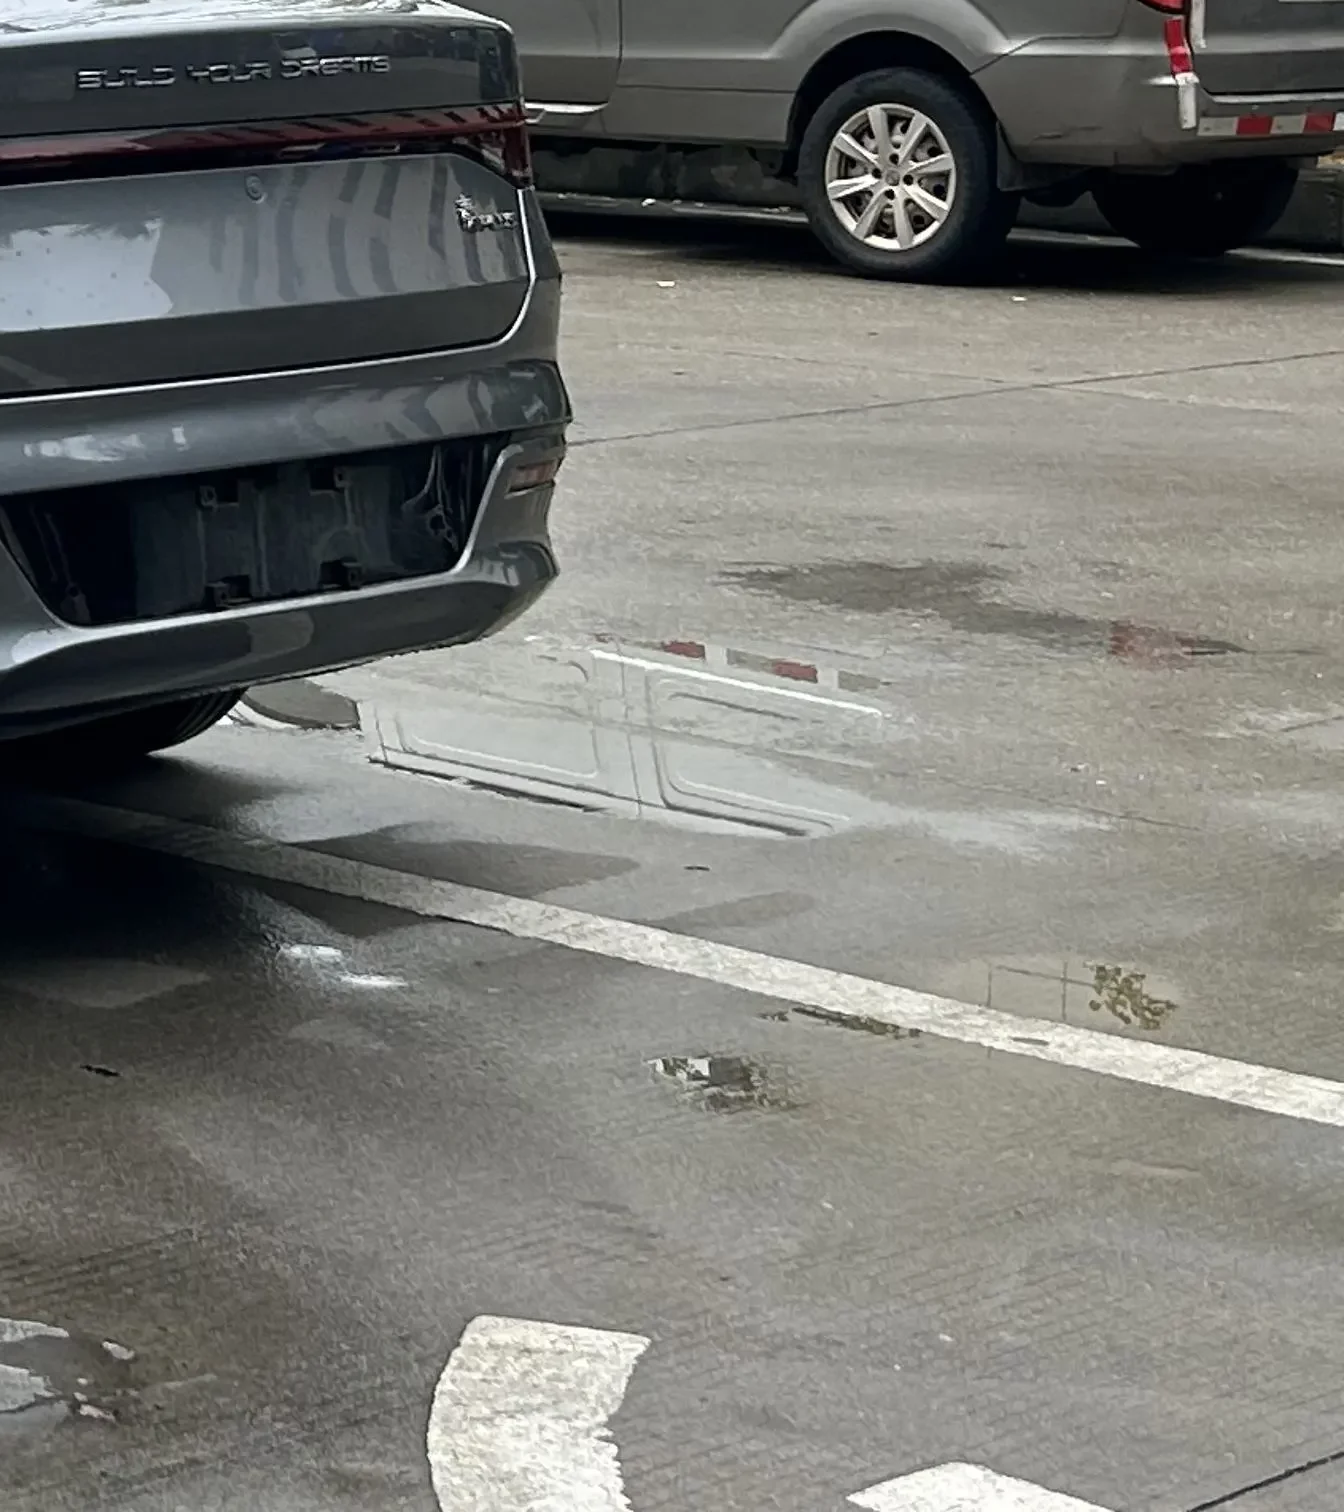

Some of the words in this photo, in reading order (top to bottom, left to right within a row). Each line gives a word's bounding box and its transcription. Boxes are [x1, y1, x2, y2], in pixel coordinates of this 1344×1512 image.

[78, 65, 175, 89] BUILD
[186, 61, 272, 84] YOUR
[280, 54, 392, 79] DREAMS
